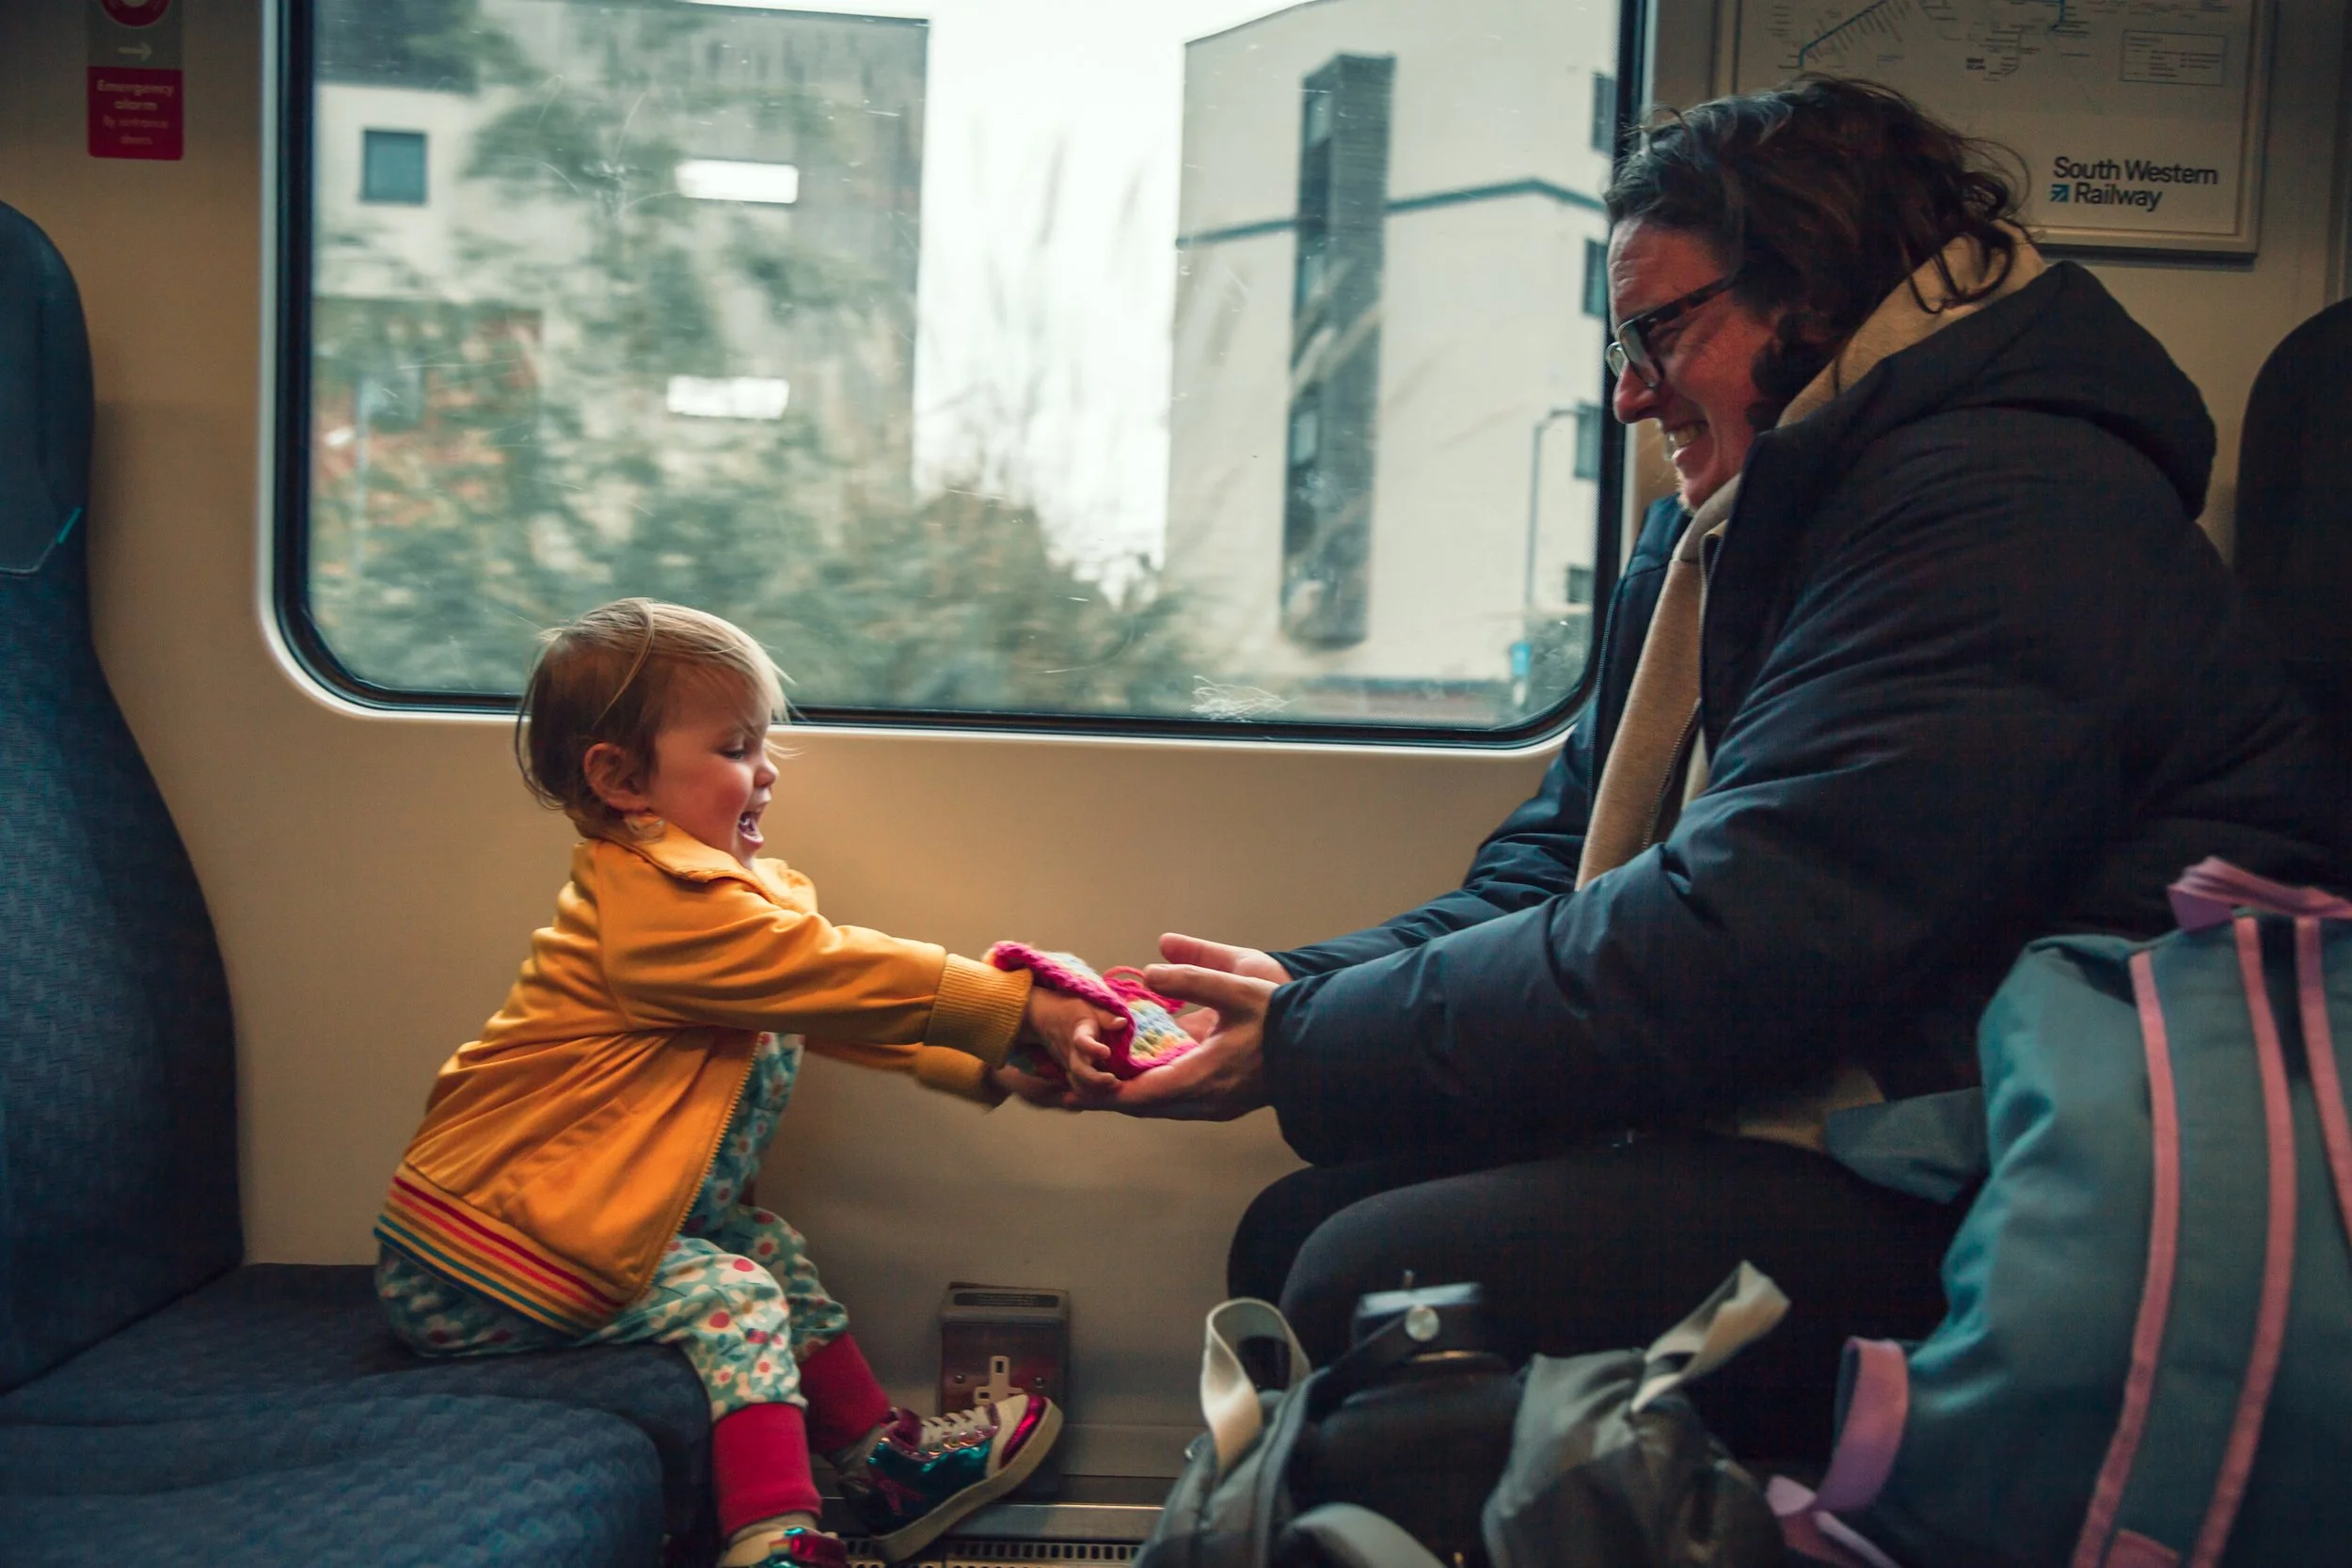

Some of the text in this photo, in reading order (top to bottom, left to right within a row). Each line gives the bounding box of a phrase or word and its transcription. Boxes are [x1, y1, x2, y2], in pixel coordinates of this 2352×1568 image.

[97, 80, 174, 97] Emergency
[2053, 156, 2217, 184] South Western
[2074, 182, 2162, 213] Railway
